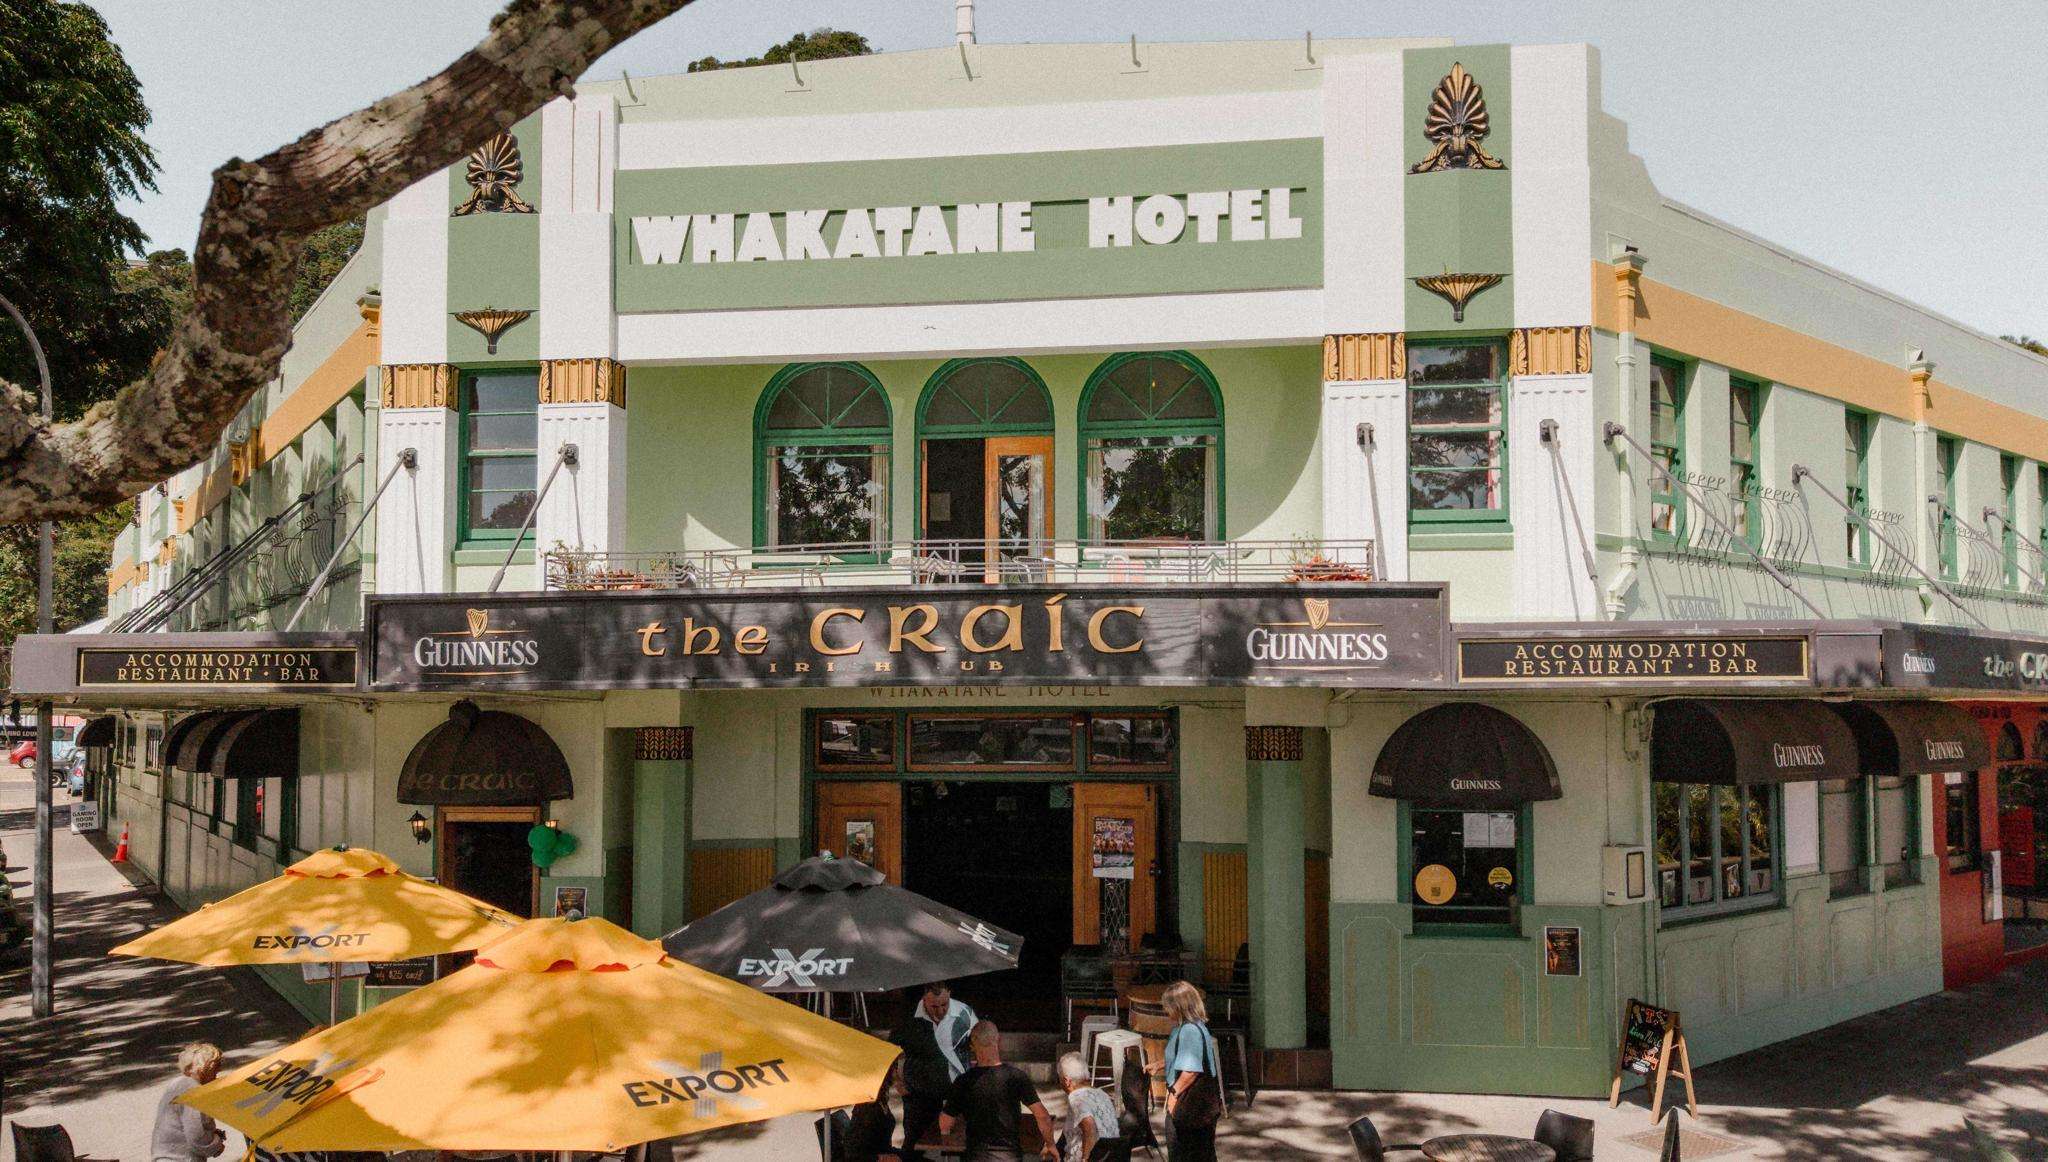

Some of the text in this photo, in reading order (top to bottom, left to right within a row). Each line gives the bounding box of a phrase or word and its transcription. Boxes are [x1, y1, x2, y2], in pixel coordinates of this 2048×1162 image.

[632, 188, 1301, 264] WHAKATANE HOTEL
[636, 617, 770, 657] the
[1246, 628, 1388, 660] GUINNESS
[126, 653, 312, 667] ACCOMMODATION
[414, 637, 539, 666] GUINNESS
[1515, 643, 1747, 659] ACCOMMODATION
[117, 668, 320, 681] RESTAURANT BAR
[1504, 659, 1759, 675] RESTAURANT BAR
[1774, 742, 1825, 768] GUINNESS
[1925, 739, 1964, 760] GUINNESS
[1451, 778, 1501, 790] GUINNESS
[253, 933, 371, 950] EXPORT
[737, 957, 854, 976] EXPORT
[245, 1059, 335, 1105] EXPOR
[623, 1058, 790, 1107] EXPORT
